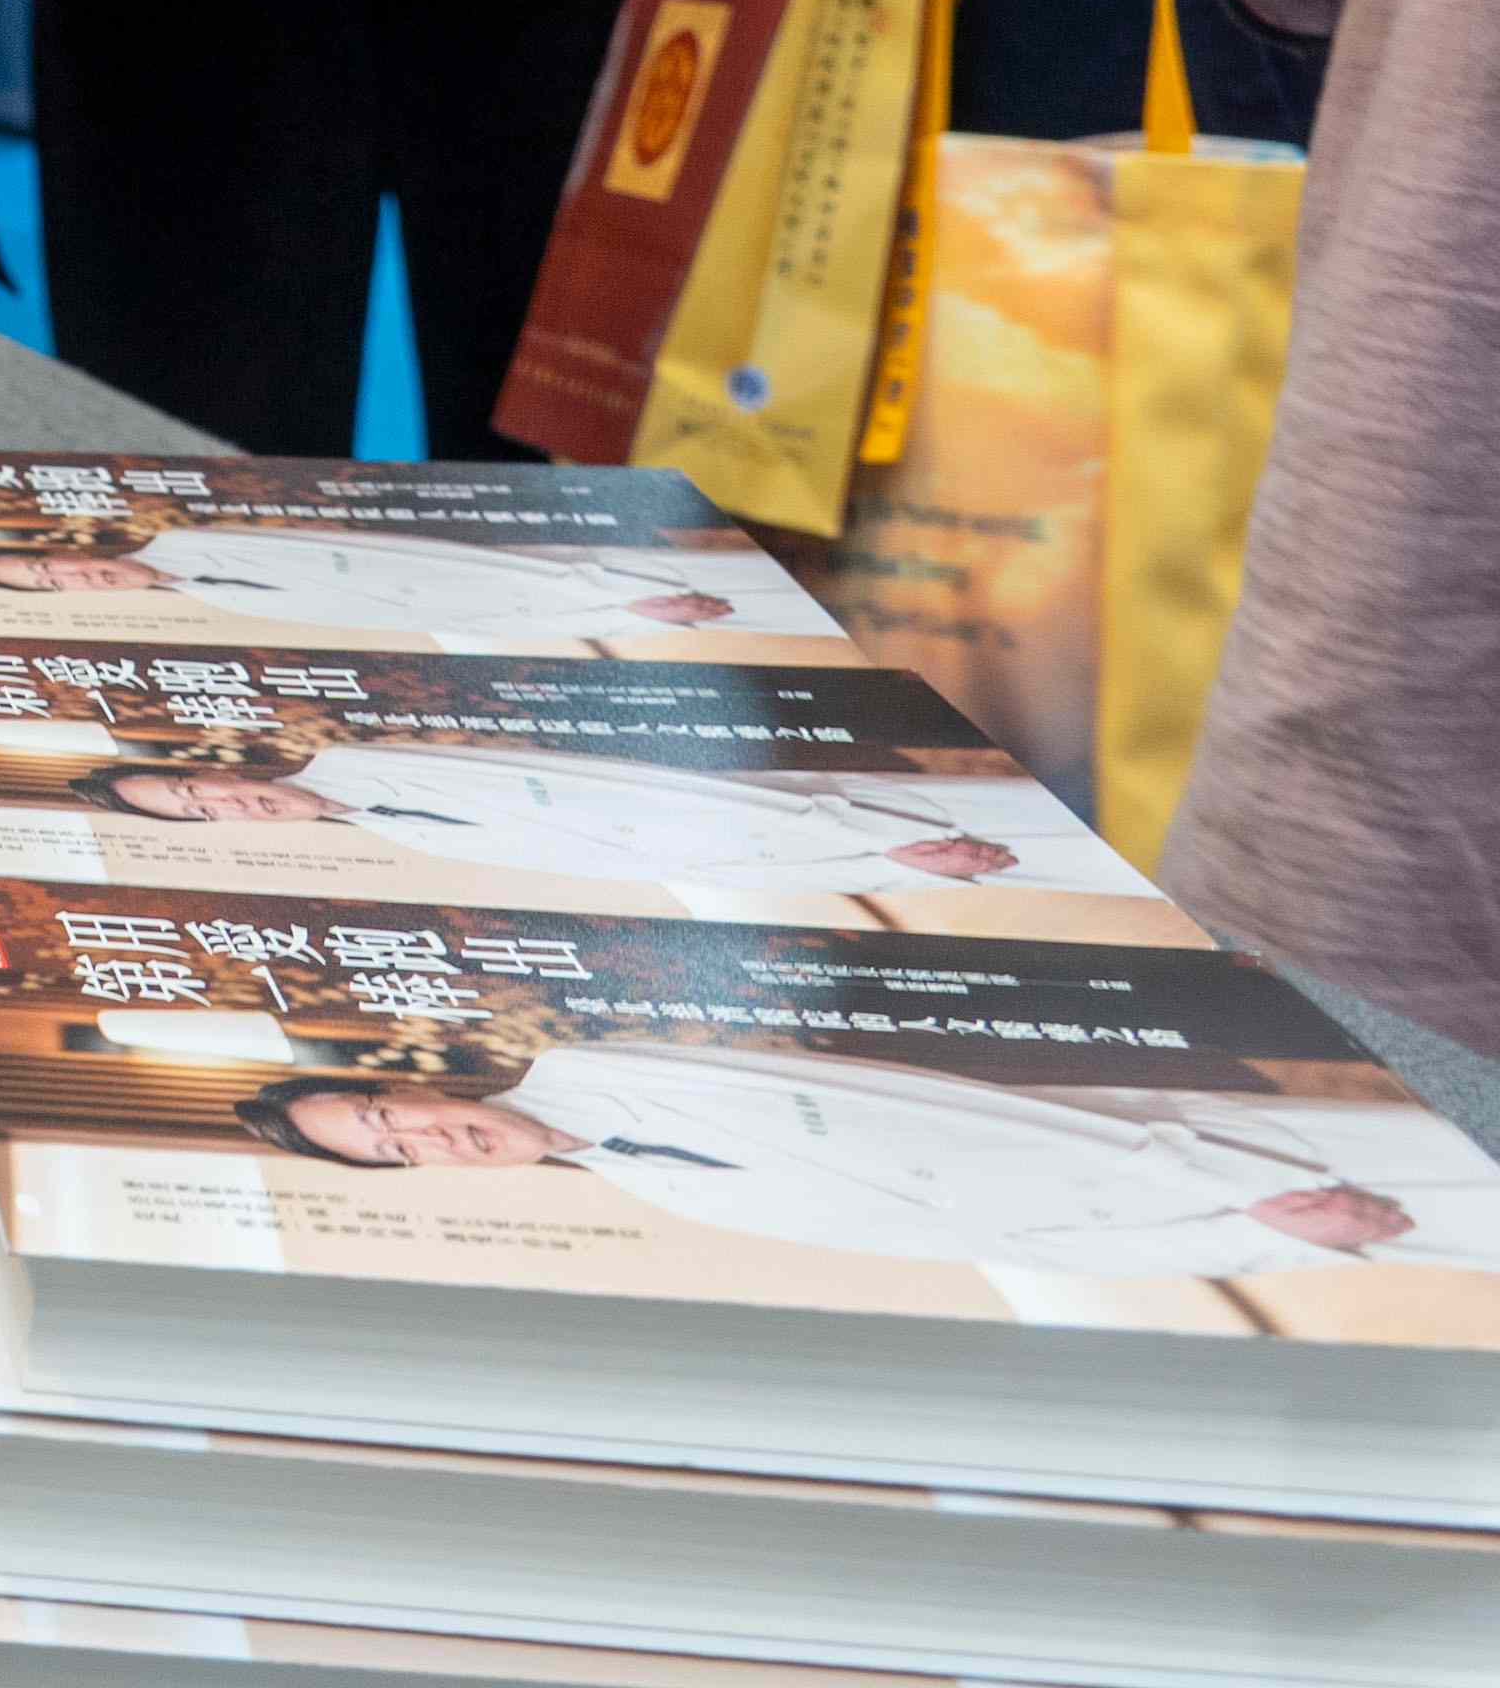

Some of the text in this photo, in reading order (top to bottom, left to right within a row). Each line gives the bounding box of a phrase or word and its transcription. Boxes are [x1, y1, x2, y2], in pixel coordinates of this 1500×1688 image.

[56, 910, 594, 982] 用愛跑出
[74, 953, 493, 1024] 第一棒
